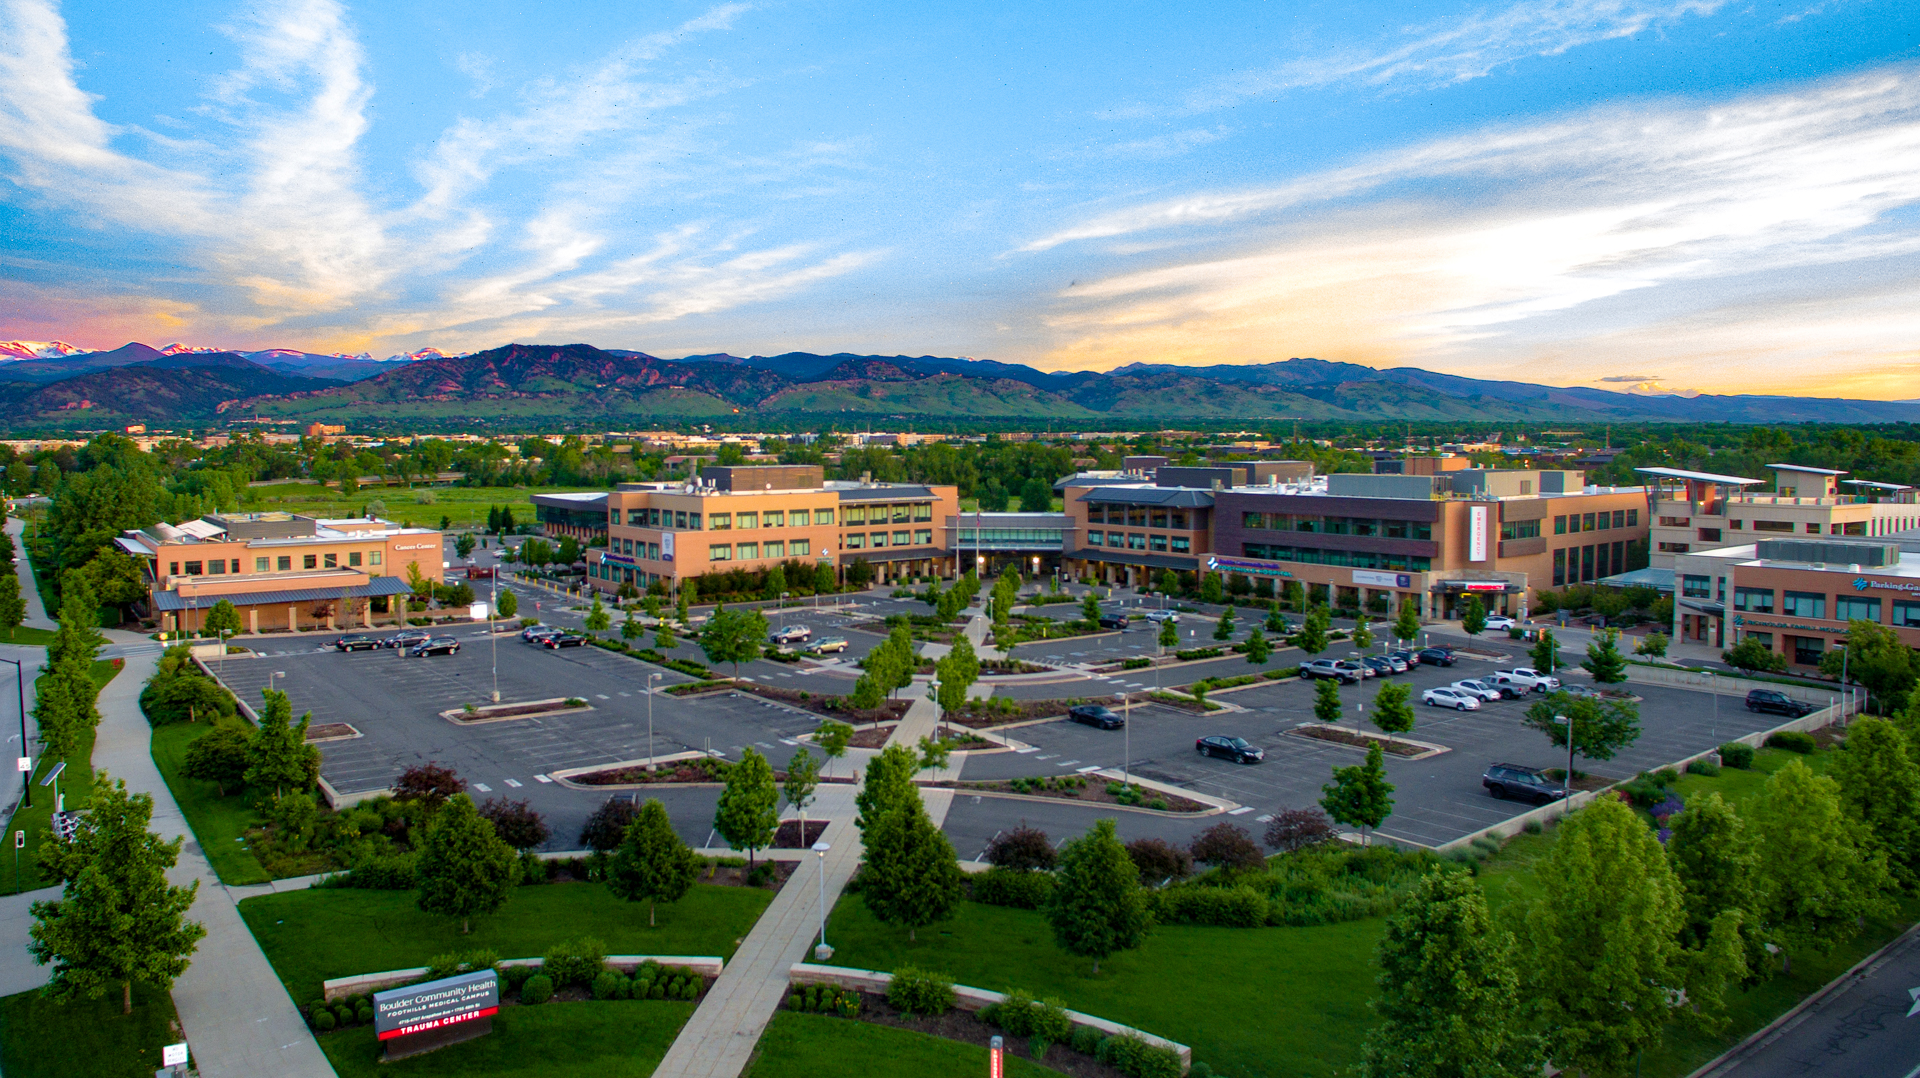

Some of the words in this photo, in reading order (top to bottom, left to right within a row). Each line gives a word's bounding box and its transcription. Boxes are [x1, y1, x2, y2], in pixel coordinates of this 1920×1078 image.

[1258, 569, 1293, 577] HOSPITAL
[1870, 580, 1904, 591] Parking
[1790, 623, 1816, 631] FAMILY
[380, 998, 414, 1012] Boulder
[415, 986, 467, 1004] Community
[468, 980, 496, 993] Health
[387, 1004, 427, 1018] FOOTHILLS
[428, 998, 460, 1008] MEDICAL
[461, 990, 490, 1002] CAMPUS
[401, 1020, 440, 1035] TRAUMA
[443, 1010, 480, 1025] CENTER
